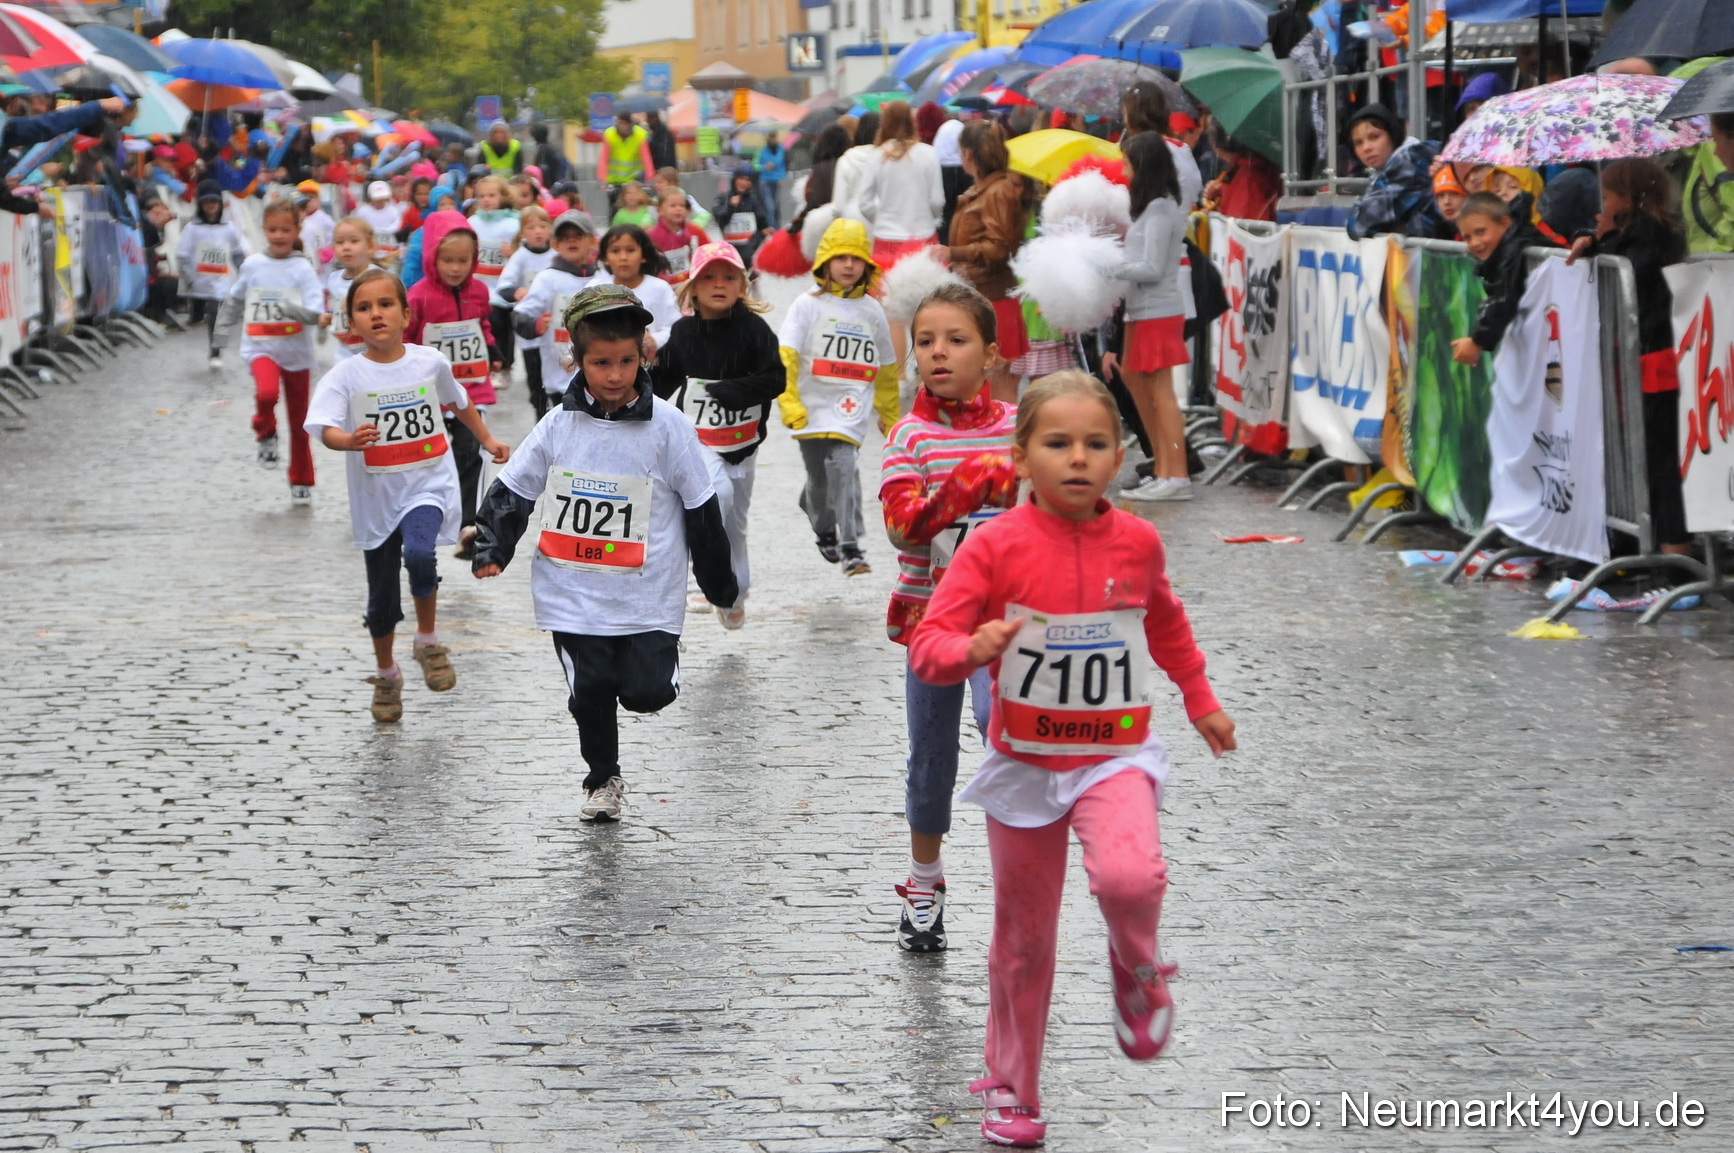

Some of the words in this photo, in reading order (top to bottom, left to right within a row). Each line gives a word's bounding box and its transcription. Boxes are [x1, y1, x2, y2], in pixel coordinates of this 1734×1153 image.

[822, 334, 874, 363] 7076
[377, 391, 416, 405] BOCK
[365, 403, 435, 442] 7283
[571, 478, 618, 492] BOCK
[556, 494, 633, 538] 7021
[575, 542, 603, 560] Lea
[1045, 623, 1112, 641] BOCK
[1018, 647, 1132, 706] 7101
[1036, 714, 1114, 743] Svenja
